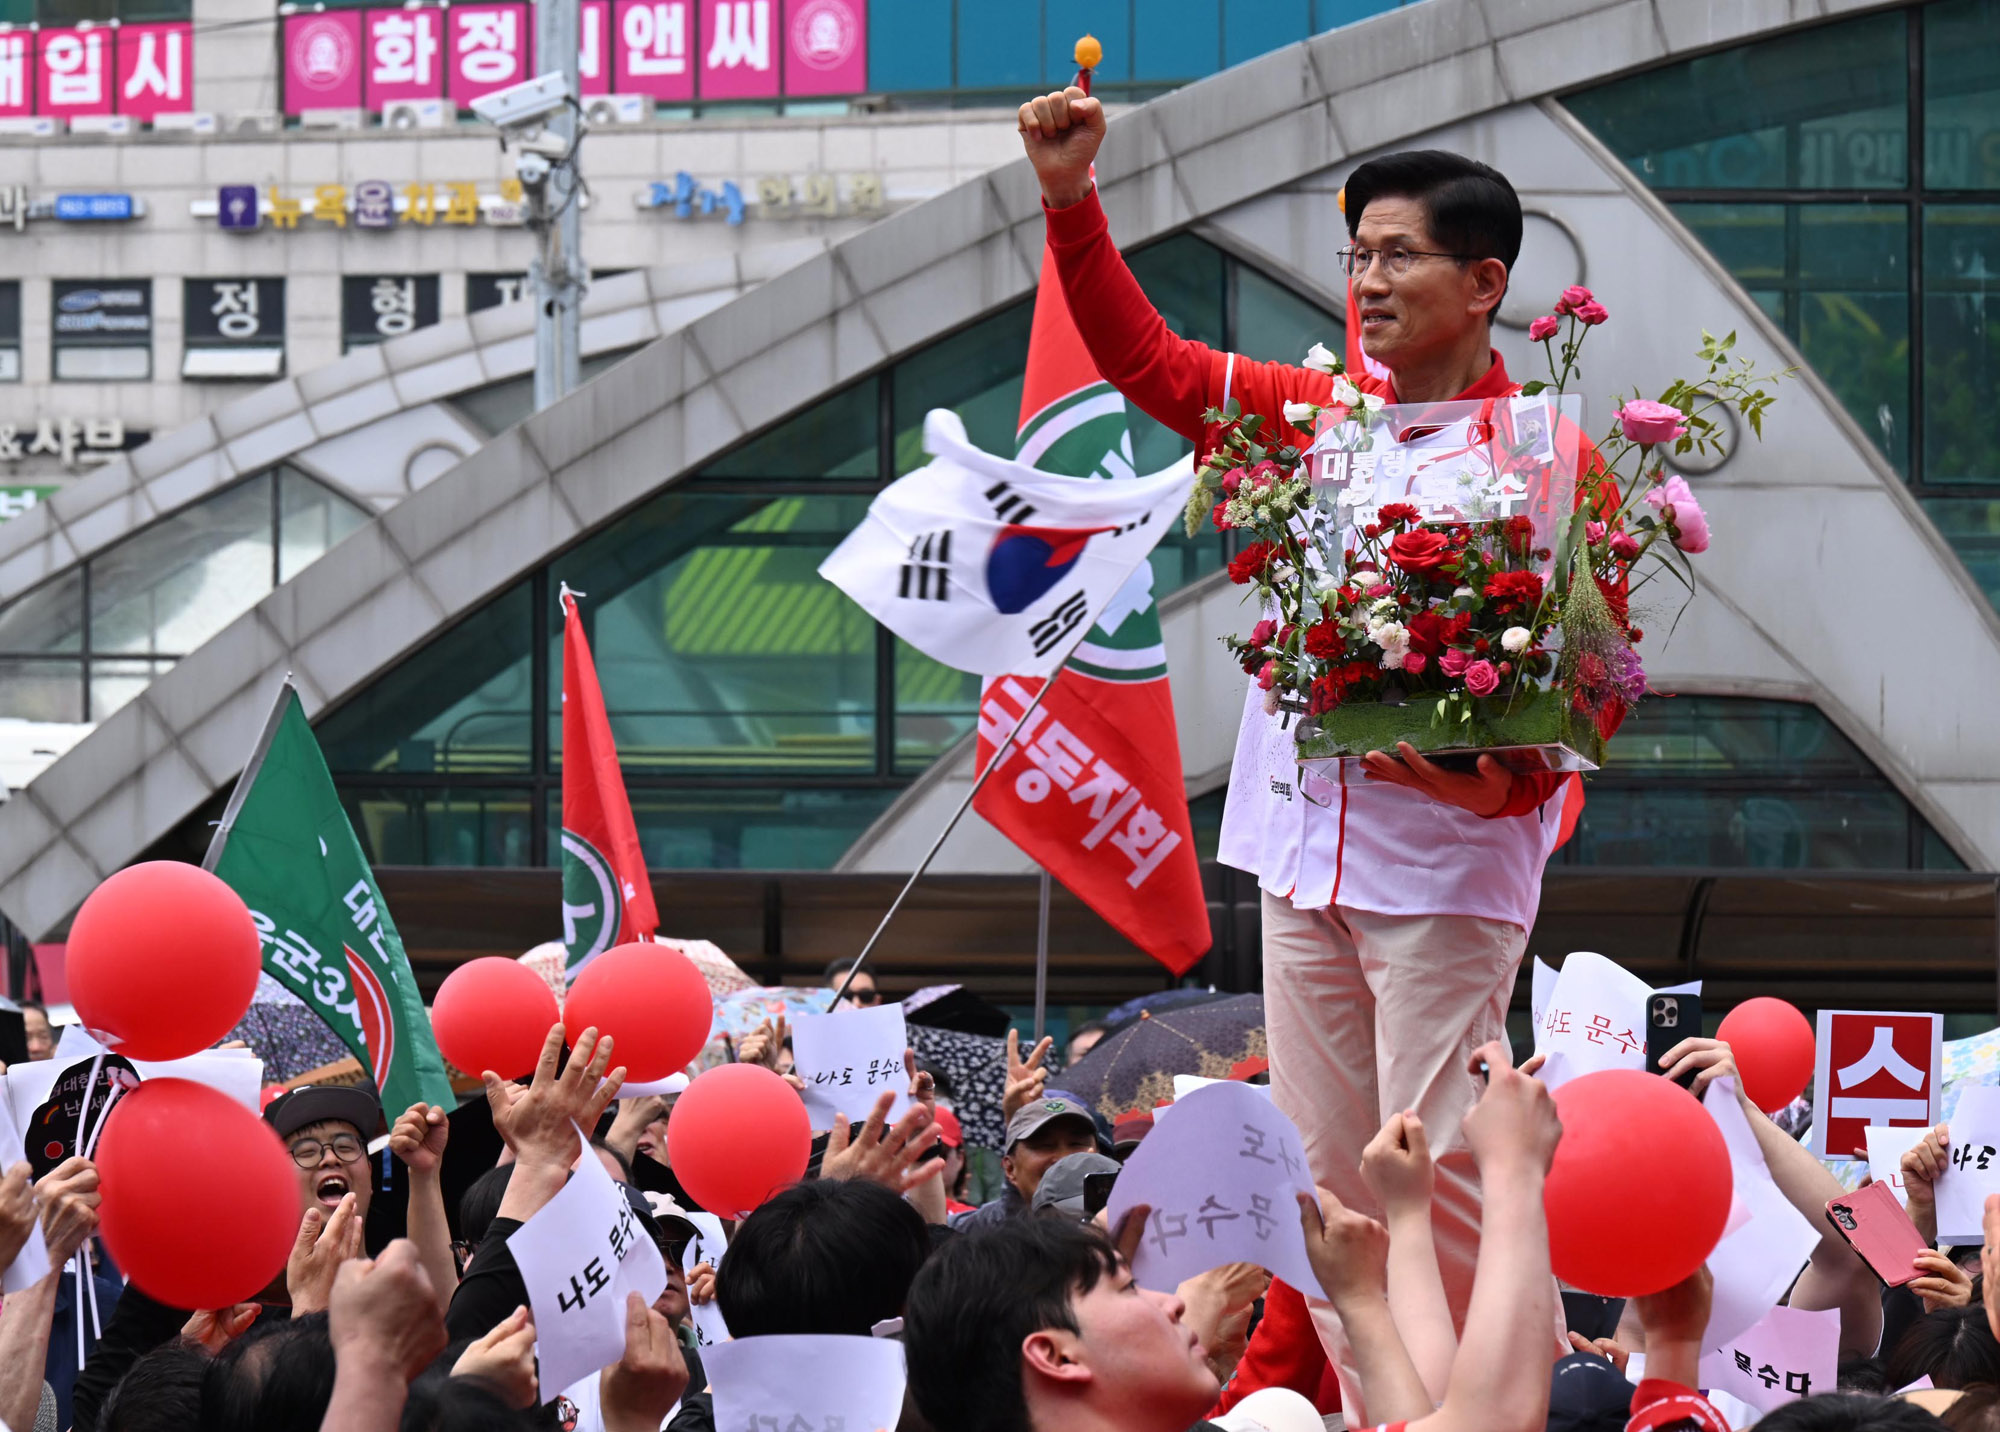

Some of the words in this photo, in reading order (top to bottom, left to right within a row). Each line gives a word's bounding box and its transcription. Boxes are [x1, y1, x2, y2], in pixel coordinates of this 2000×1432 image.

[1547, 1009, 1572, 1038] 나도
[815, 1067, 854, 1086] 나도
[1831, 1026, 1928, 1127] 수
[1953, 1143, 1997, 1171] 나도
[557, 1256, 610, 1313] 나도
[1734, 1348, 1812, 1399] 문수다
